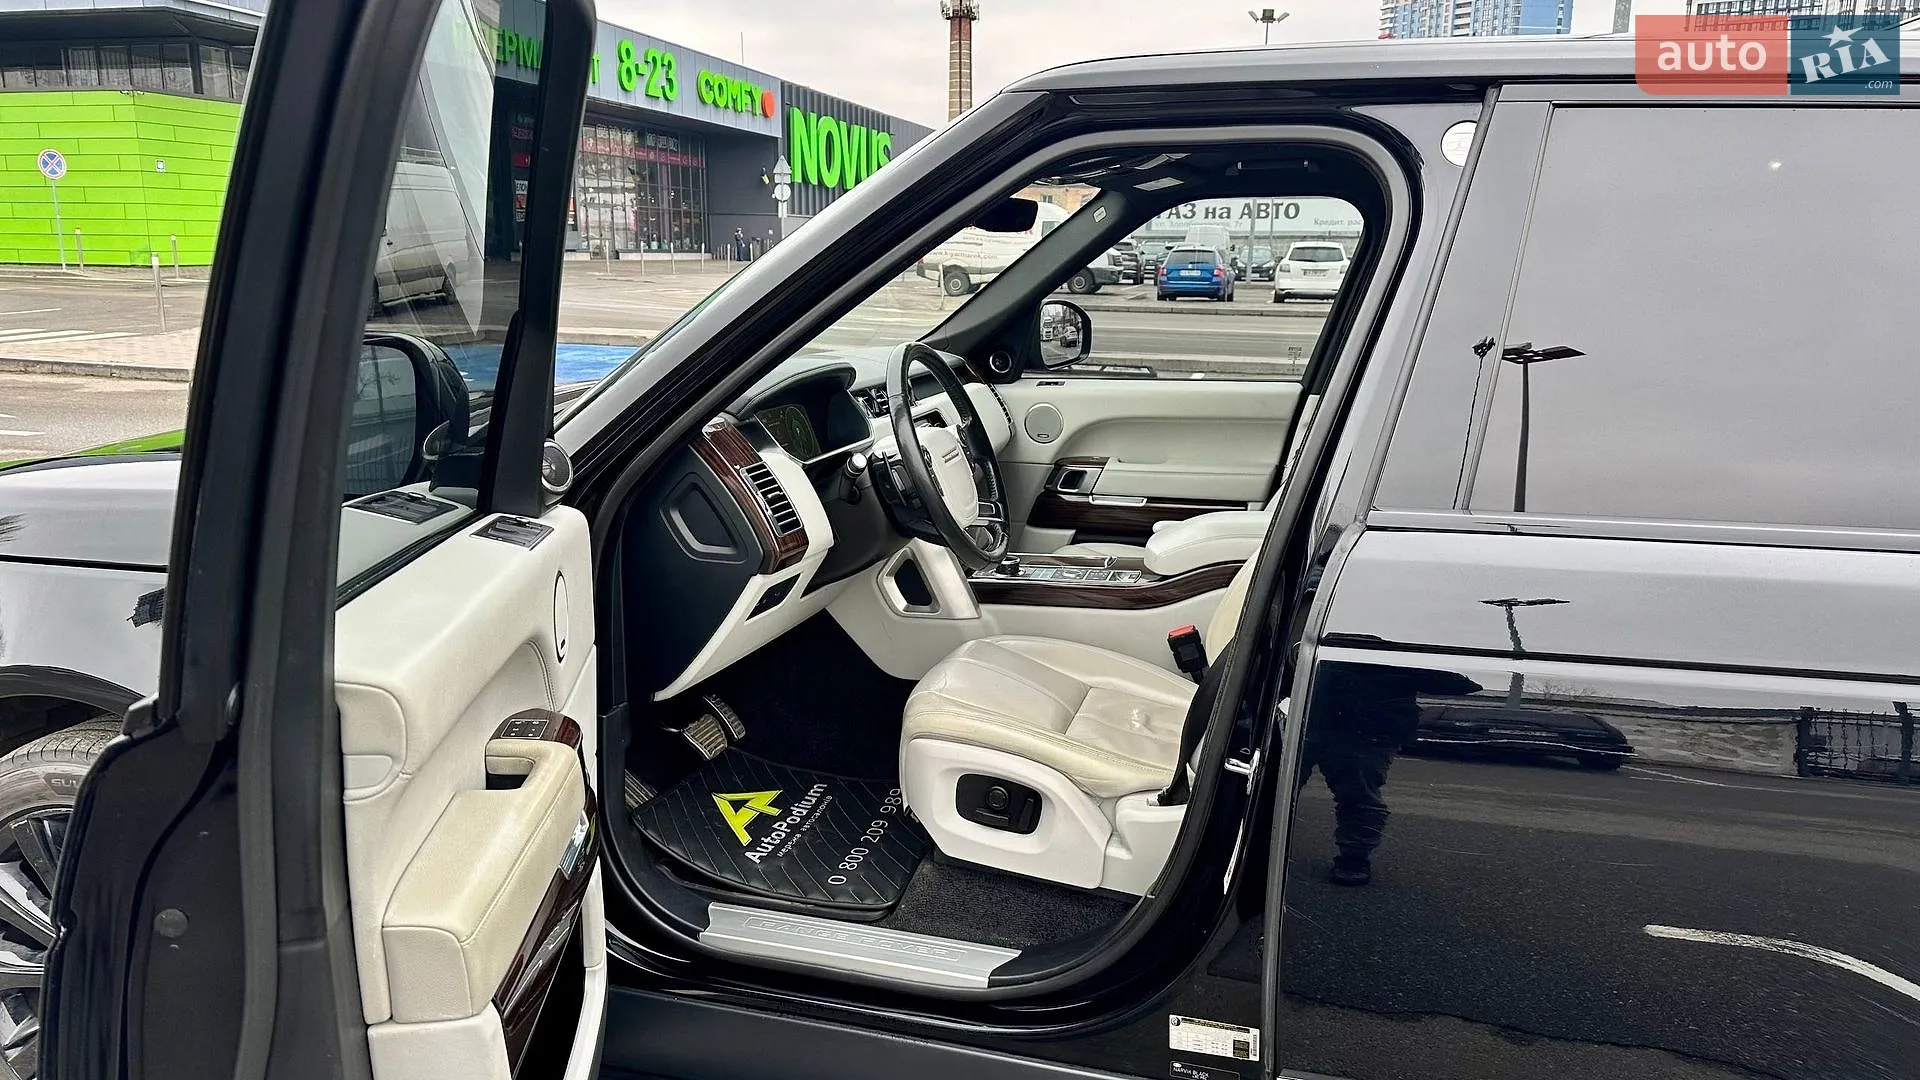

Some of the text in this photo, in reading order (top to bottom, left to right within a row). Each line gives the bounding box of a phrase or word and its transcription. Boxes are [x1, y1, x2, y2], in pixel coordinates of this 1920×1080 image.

[617, 39, 678, 101] 8-23
[697, 69, 763, 117] COMFY
[789, 107, 892, 190] NOVUS
[1156, 202, 1300, 219] АЗ на АВТО
[744, 783, 828, 864] AutoPodium
[777, 833, 802, 857] мережа
[828, 875, 847, 885] 0
[839, 847, 869, 870] 800
[861, 819, 888, 843] 209
